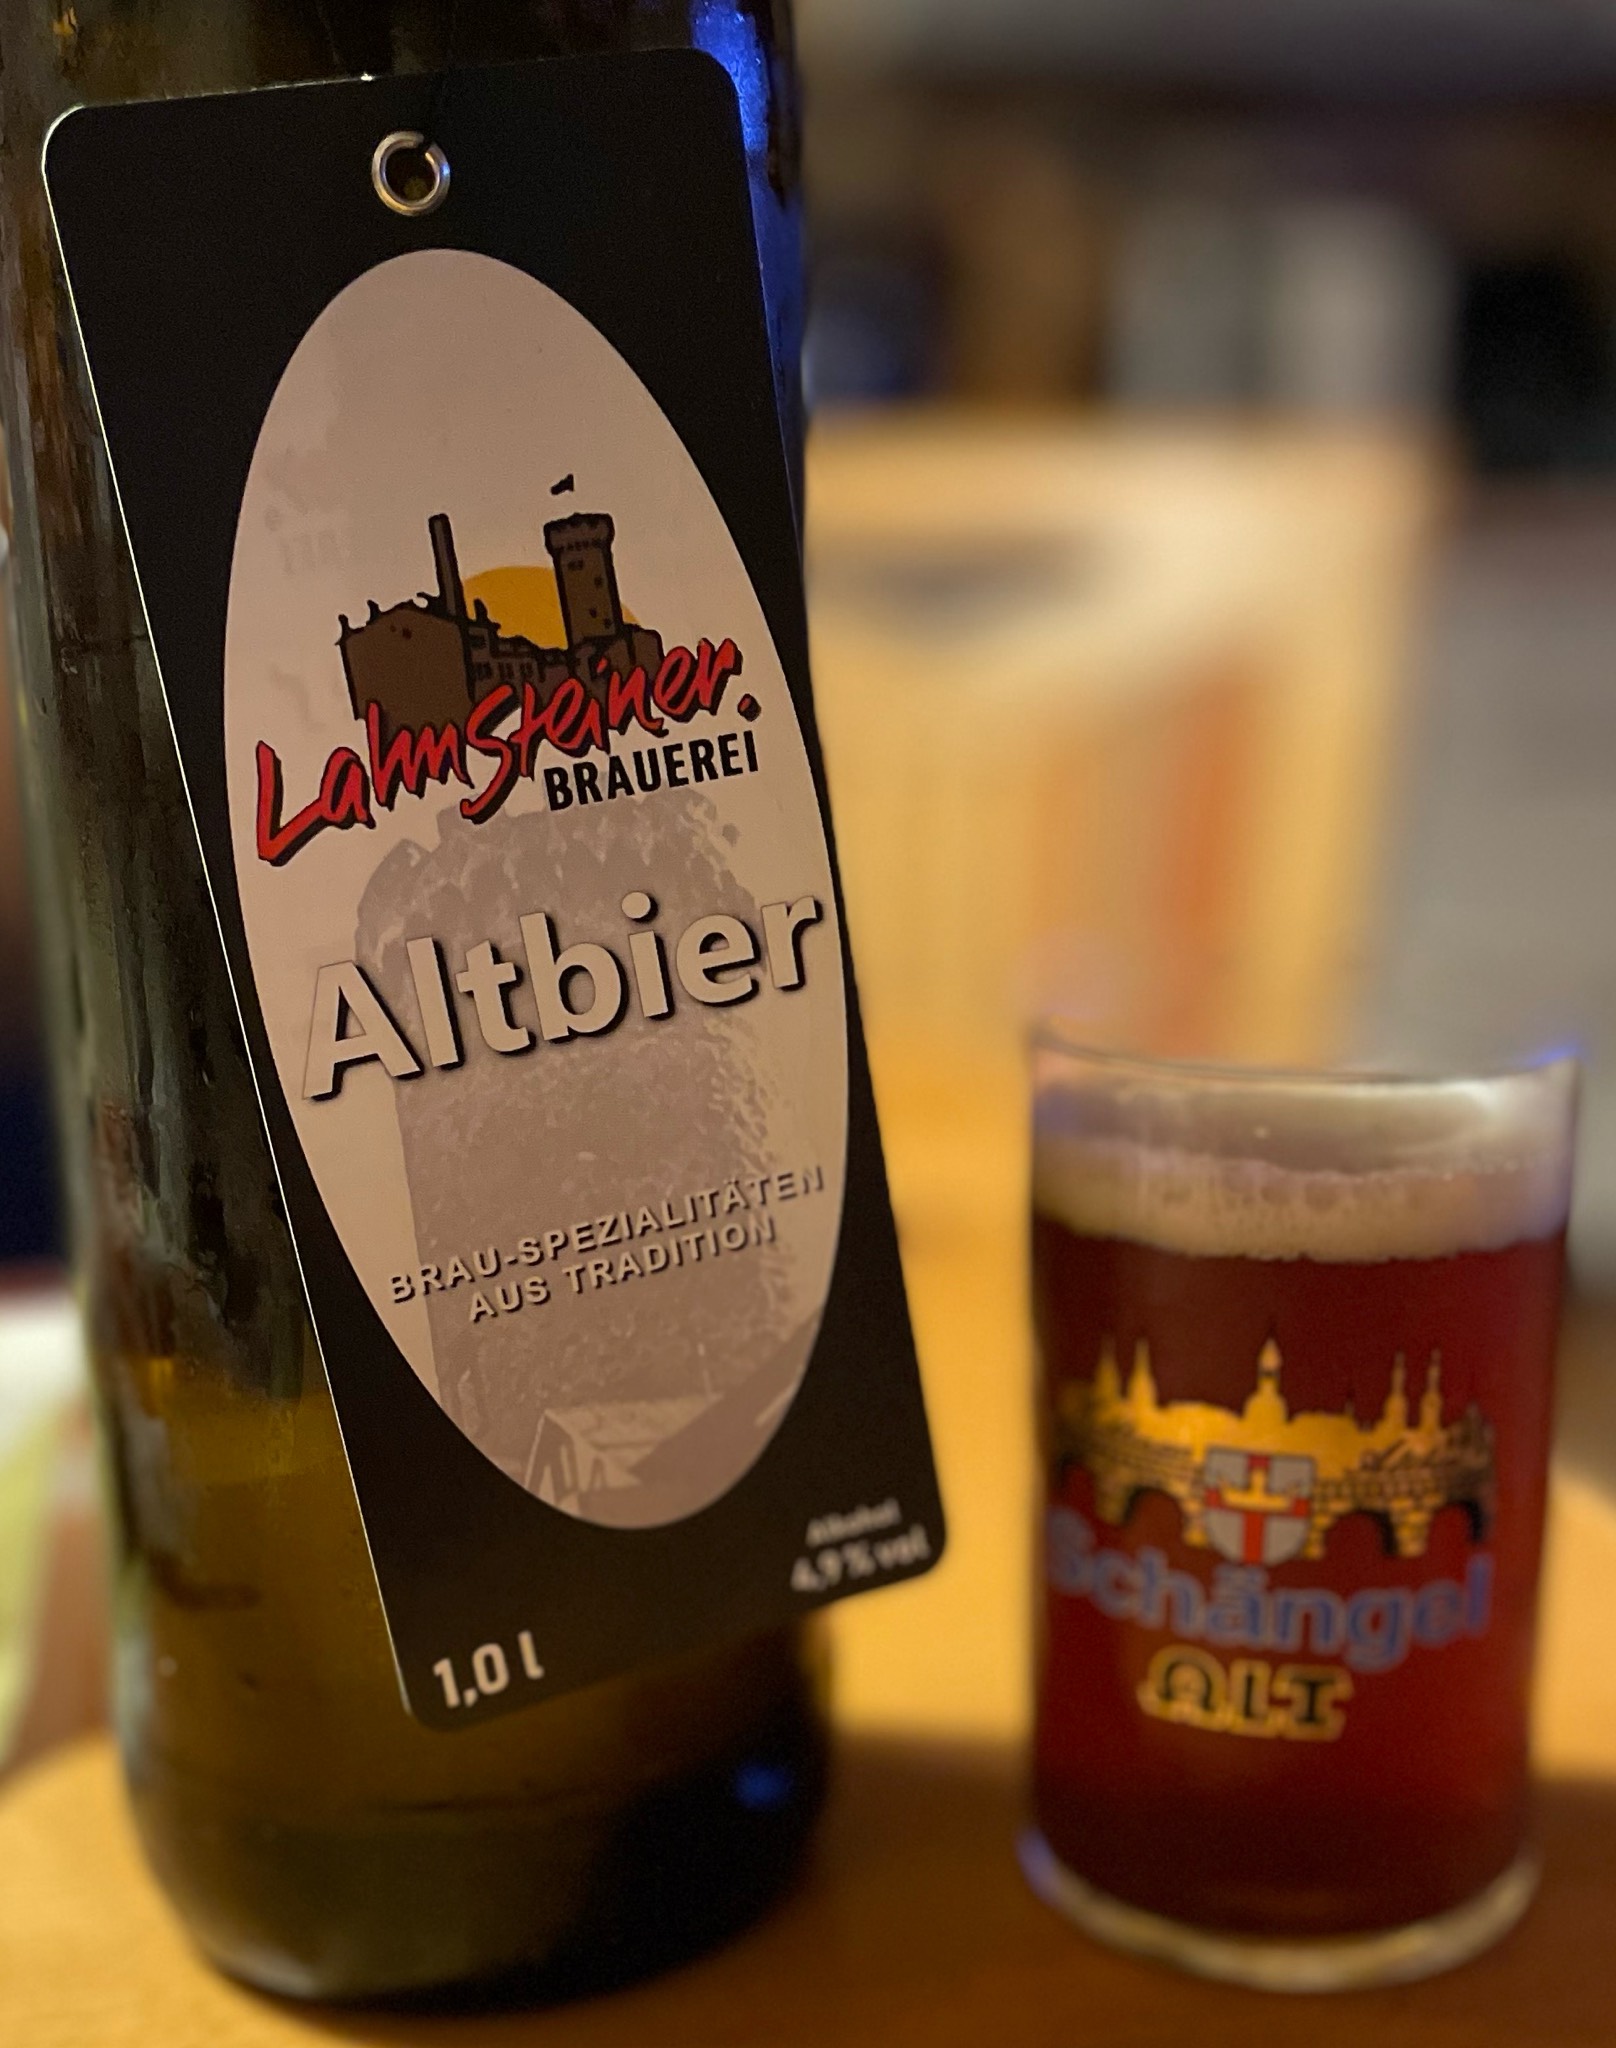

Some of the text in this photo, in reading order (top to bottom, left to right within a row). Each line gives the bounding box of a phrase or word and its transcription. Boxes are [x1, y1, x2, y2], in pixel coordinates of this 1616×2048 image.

[543, 730, 759, 811] BRAUEREI
[303, 891, 824, 1101] Altbier
[390, 1166, 824, 1304] BRAU-SPEZIALITÄTEN
[470, 1213, 777, 1324] AUS TRADITION
[433, 1643, 509, 1709] 1,0
